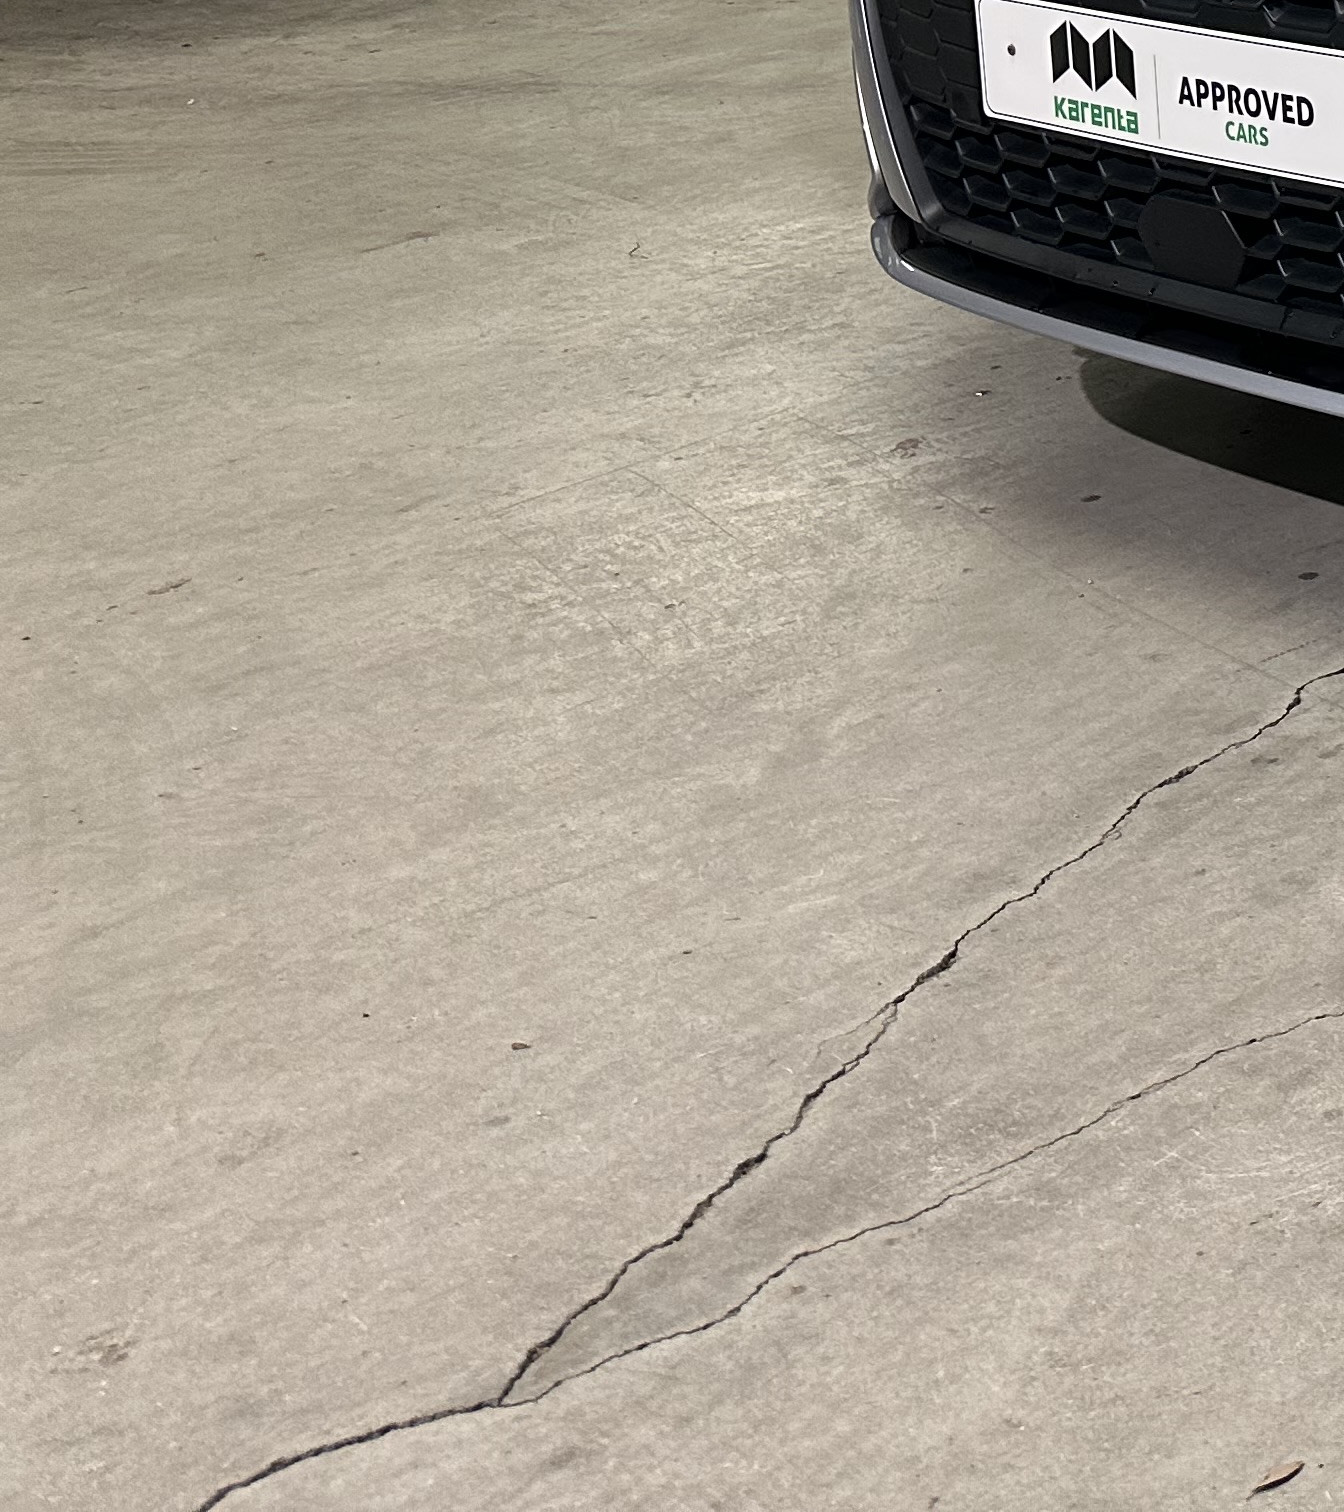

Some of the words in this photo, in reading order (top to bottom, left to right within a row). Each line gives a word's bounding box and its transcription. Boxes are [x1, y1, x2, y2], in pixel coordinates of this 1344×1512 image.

[1054, 96, 1139, 134] Karenta
[1178, 76, 1314, 127] APPROVED
[1224, 120, 1269, 147] CARS
